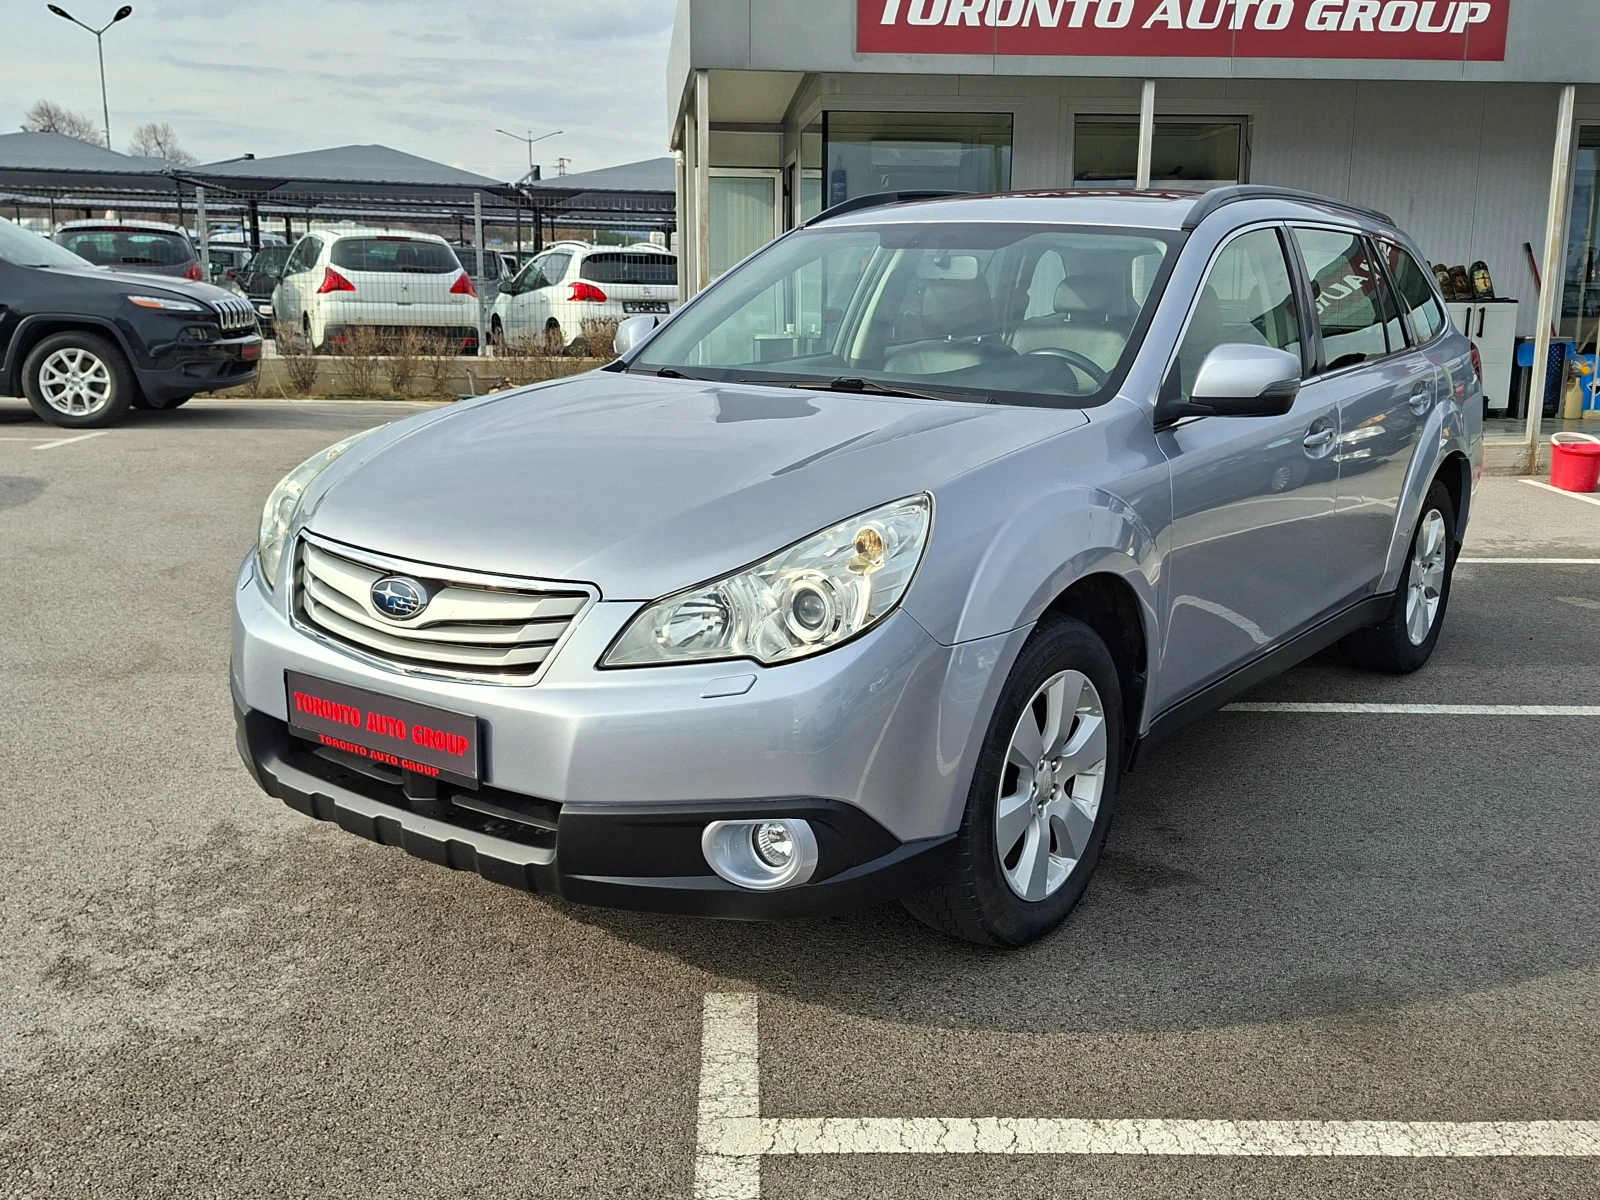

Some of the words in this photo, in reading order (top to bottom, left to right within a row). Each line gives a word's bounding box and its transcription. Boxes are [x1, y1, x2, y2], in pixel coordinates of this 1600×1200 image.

[880, 0, 1133, 28] TORONTO
[1142, 0, 1292, 30] AUTO
[1305, 0, 1491, 33] GROUP
[293, 691, 361, 728] TORONTO
[366, 711, 407, 741] AUTO
[411, 725, 469, 757] GROUP
[319, 734, 367, 756] TORONTO
[370, 750, 399, 766] AUTO
[401, 759, 440, 777] GROUP
